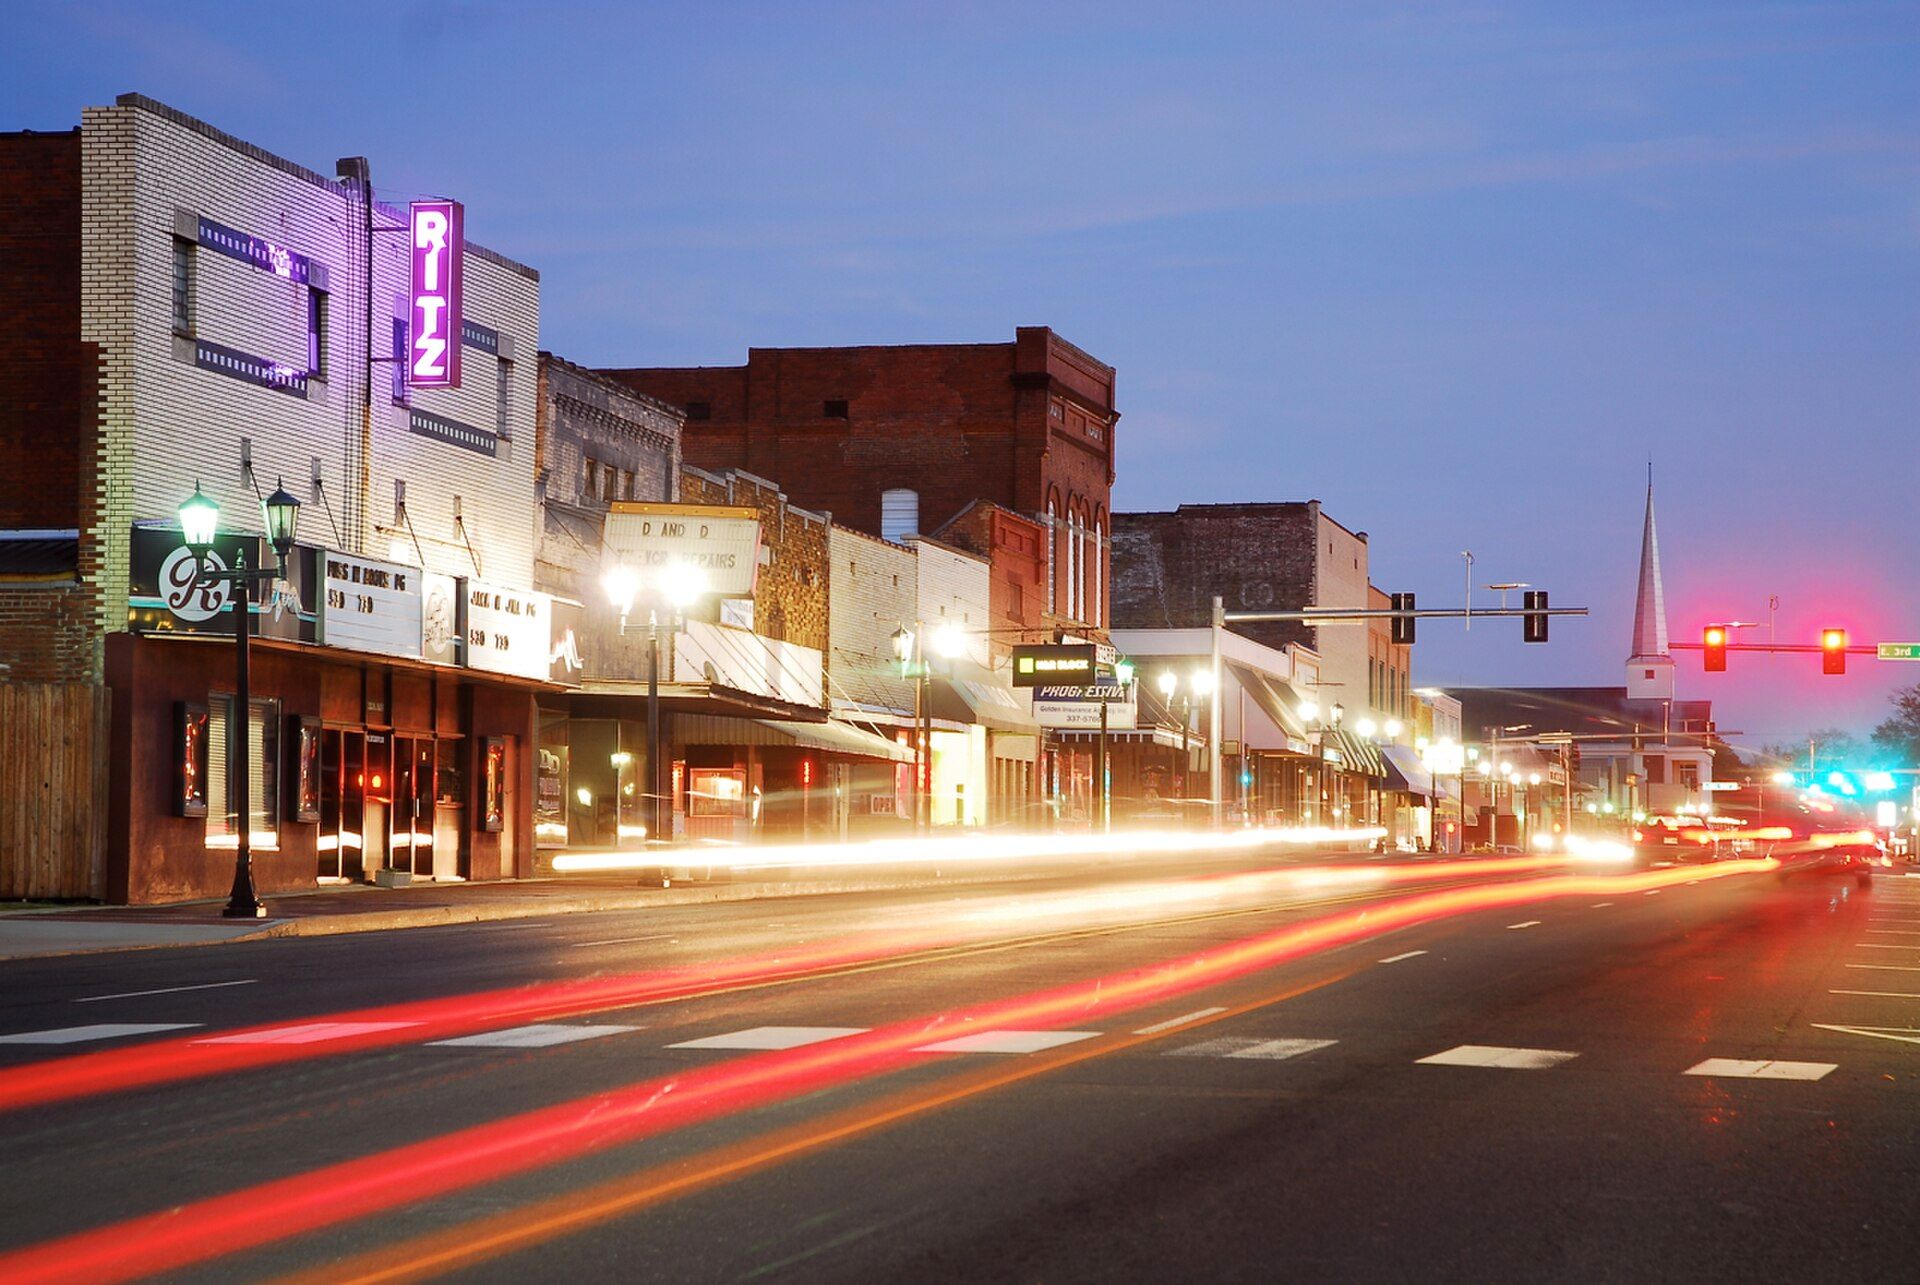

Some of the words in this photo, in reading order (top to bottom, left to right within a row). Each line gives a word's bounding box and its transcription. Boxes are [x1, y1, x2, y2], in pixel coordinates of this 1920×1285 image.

[413, 211, 448, 377] RITZ
[642, 522, 651, 535] D
[661, 522, 685, 537] AND
[700, 525, 709, 538] D
